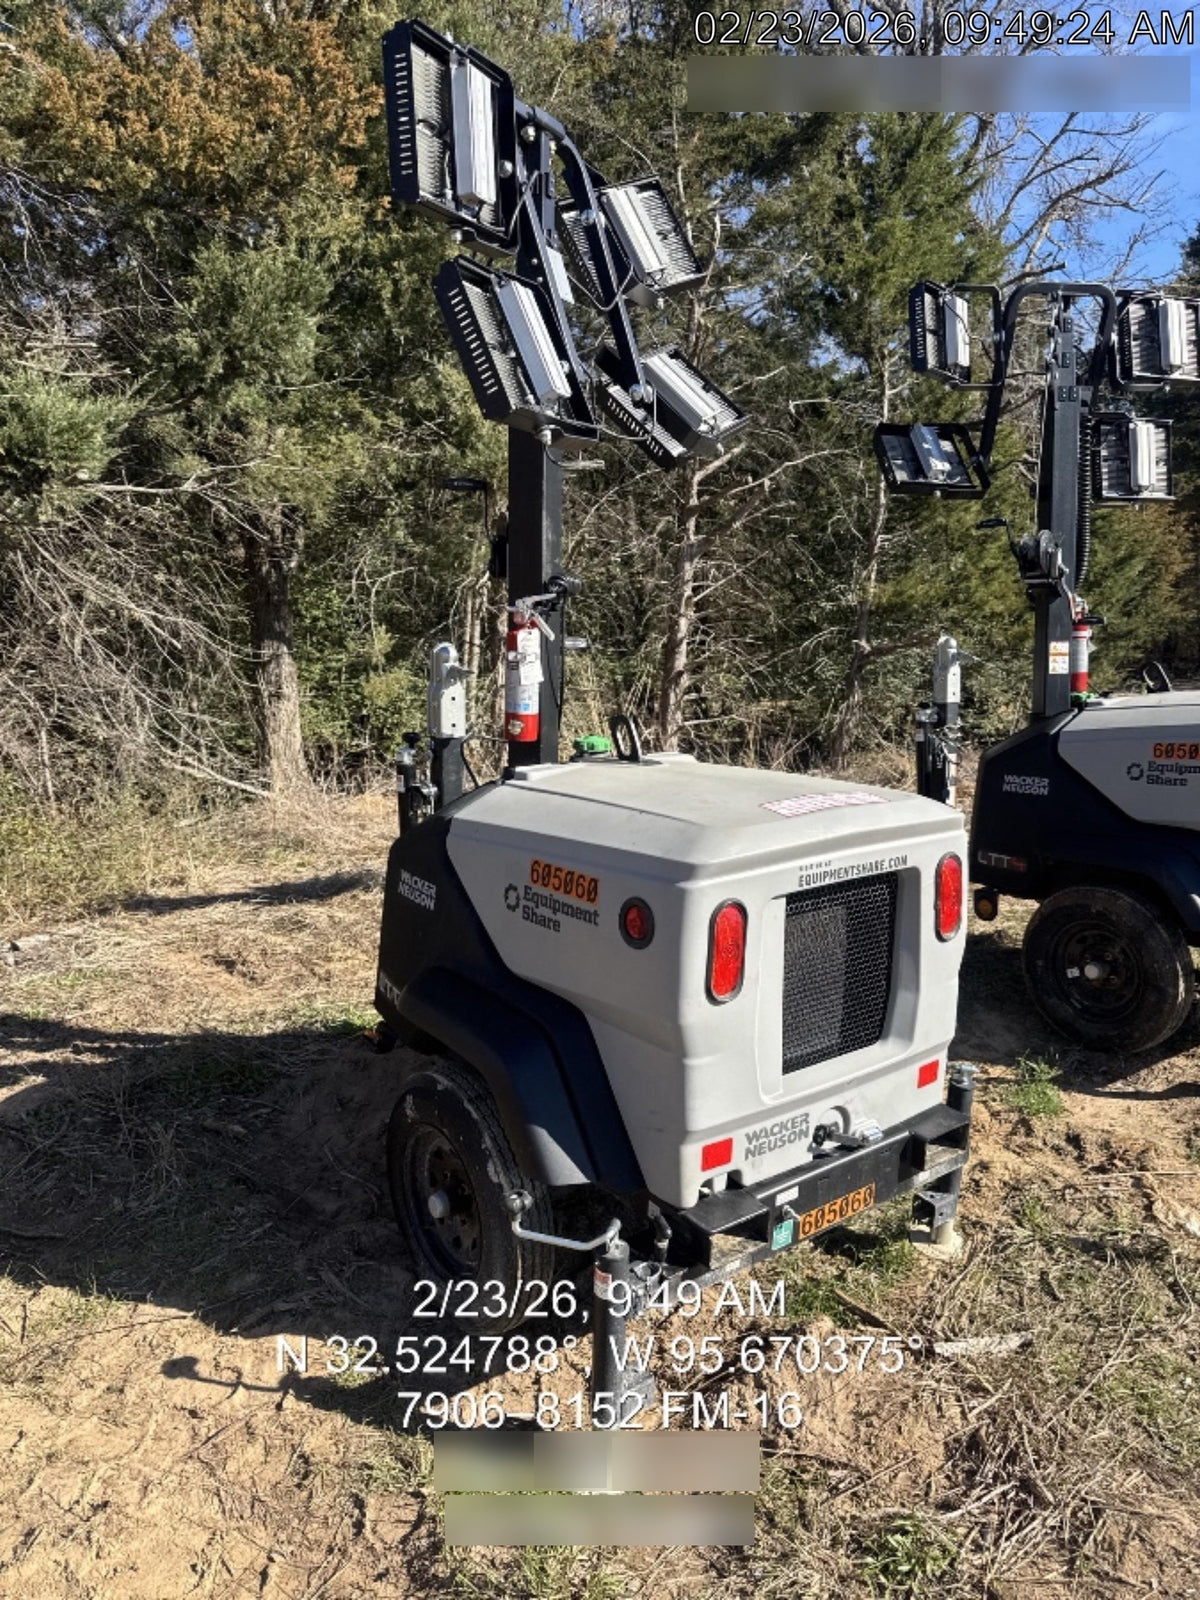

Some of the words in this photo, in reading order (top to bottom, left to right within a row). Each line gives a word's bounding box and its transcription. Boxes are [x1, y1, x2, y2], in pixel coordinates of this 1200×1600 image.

[1153, 742, 1199, 760] 6050
[1002, 783, 1049, 796] NEUSON
[1003, 774, 1050, 787] WACKER
[1146, 774, 1188, 787] Share
[400, 869, 437, 899] WACKER
[530, 859, 600, 904] 605060
[798, 854, 908, 888] EQUIPMENTSHARE.COM
[397, 881, 436, 911] NEUSON
[522, 884, 600, 928] Equipment
[522, 904, 561, 933] Share
[744, 1112, 810, 1146] WACKER
[744, 1125, 810, 1161] NEUSON
[801, 1187, 874, 1236] 605060
